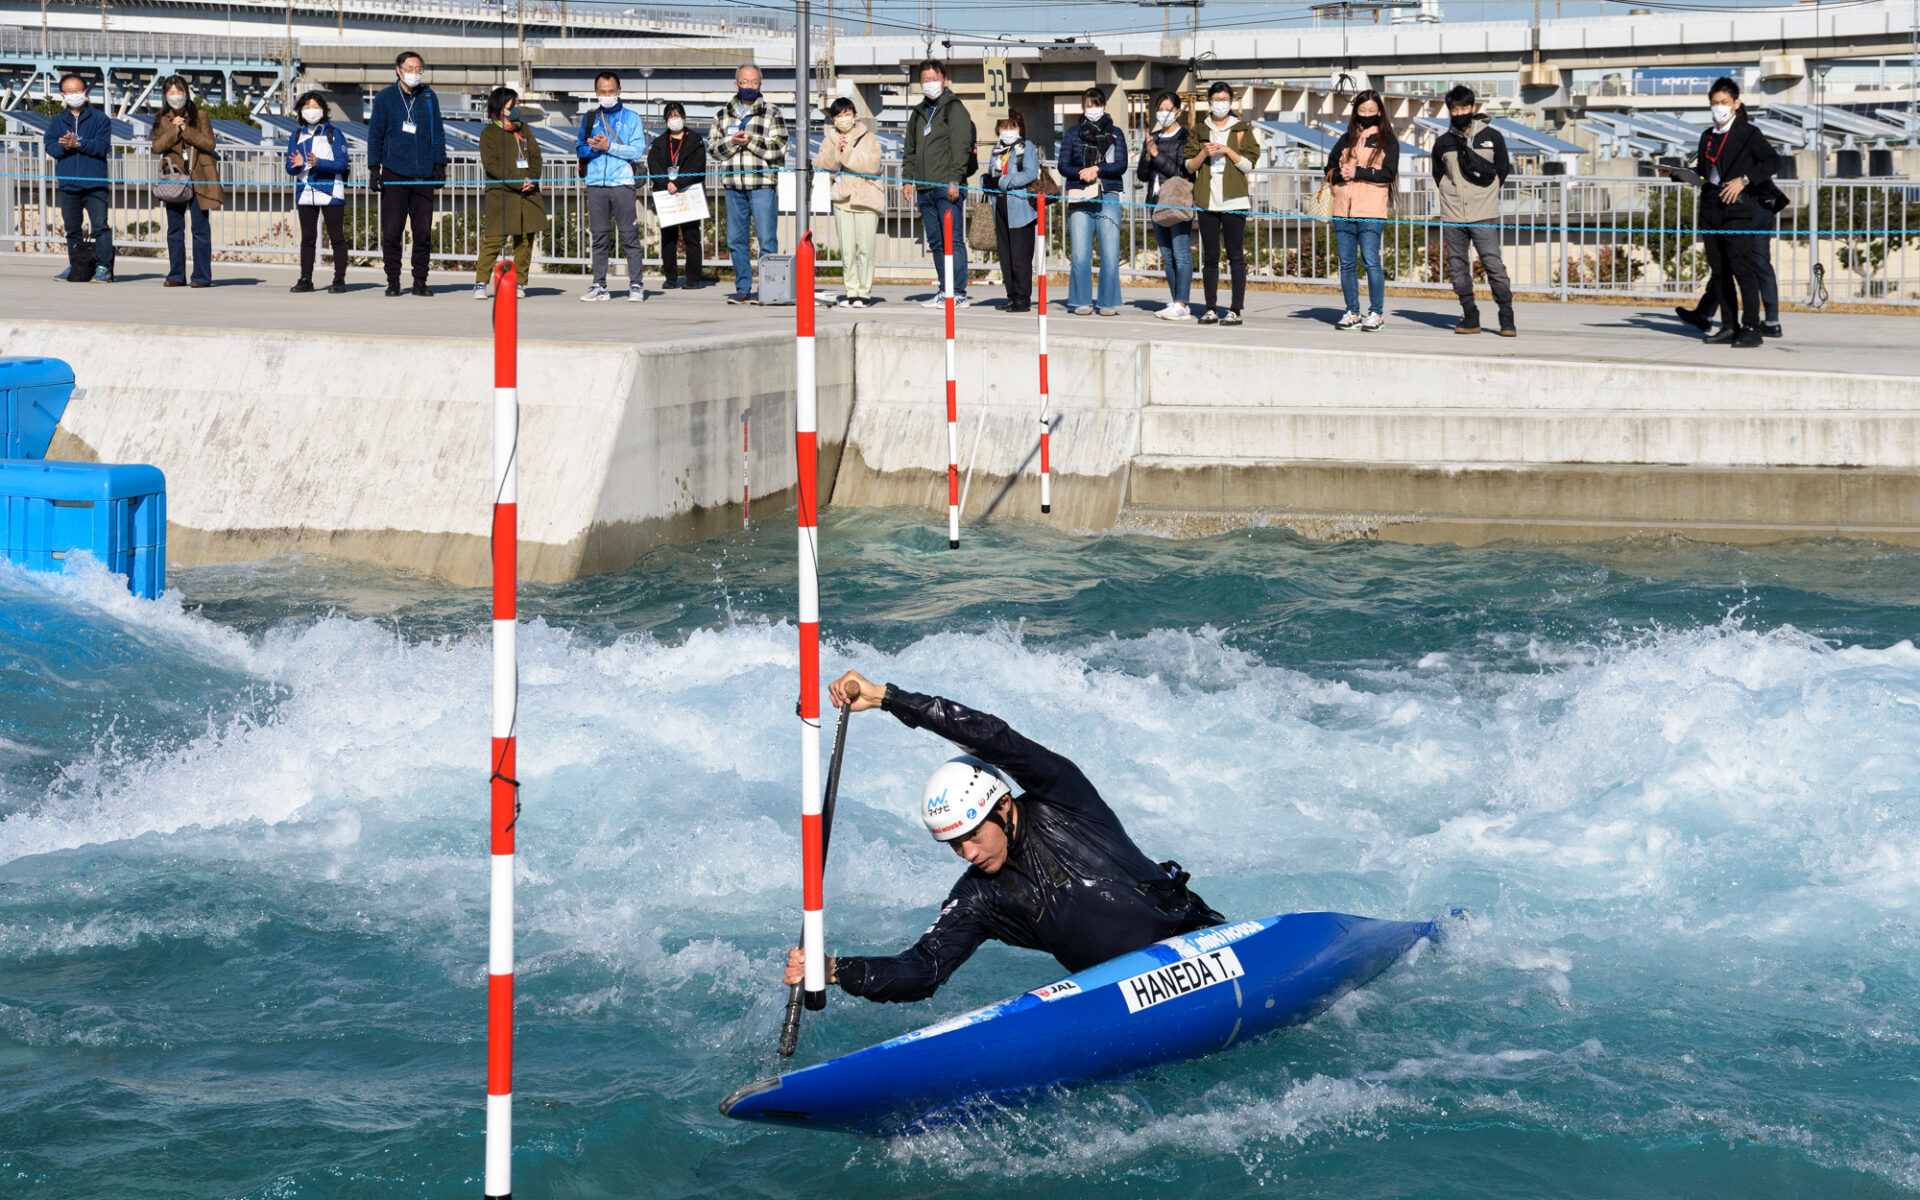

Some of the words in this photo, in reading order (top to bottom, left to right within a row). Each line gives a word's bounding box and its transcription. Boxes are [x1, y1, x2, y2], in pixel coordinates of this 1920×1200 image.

[988, 69, 1005, 107] 33
[986, 785, 997, 801] JAL
[928, 805, 950, 816] マイナビ
[1050, 982, 1076, 993] JAL
[1130, 958, 1217, 1007] HANEDA
[1210, 952, 1235, 978] T.
